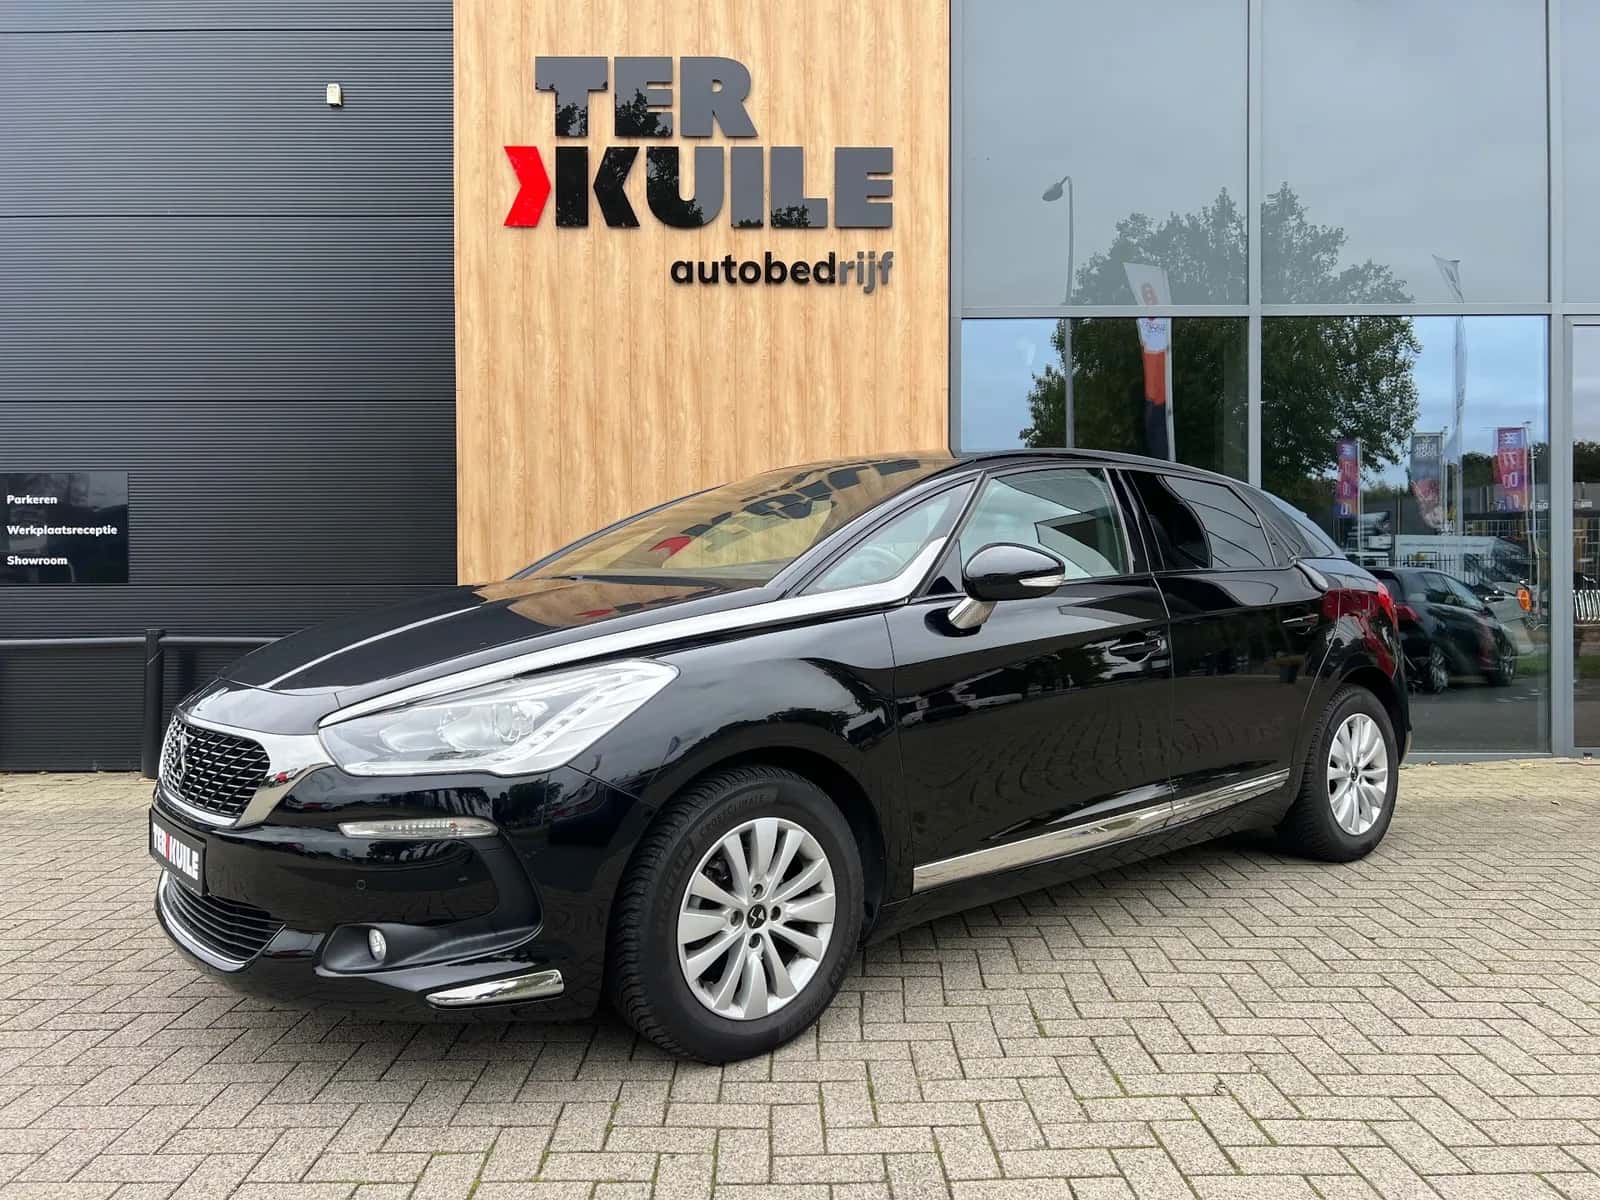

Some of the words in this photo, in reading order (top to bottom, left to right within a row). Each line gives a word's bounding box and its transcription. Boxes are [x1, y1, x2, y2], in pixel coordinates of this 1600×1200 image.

[535, 56, 758, 137] TER
[556, 146, 893, 227] KUILE
[670, 251, 894, 293] autobedrijf
[6, 494, 58, 505] Parkeren
[6, 525, 118, 537] Werkplaatsreceptie
[6, 555, 68, 566] Showroom
[152, 822, 167, 859] TER
[168, 834, 199, 881] KUILE
